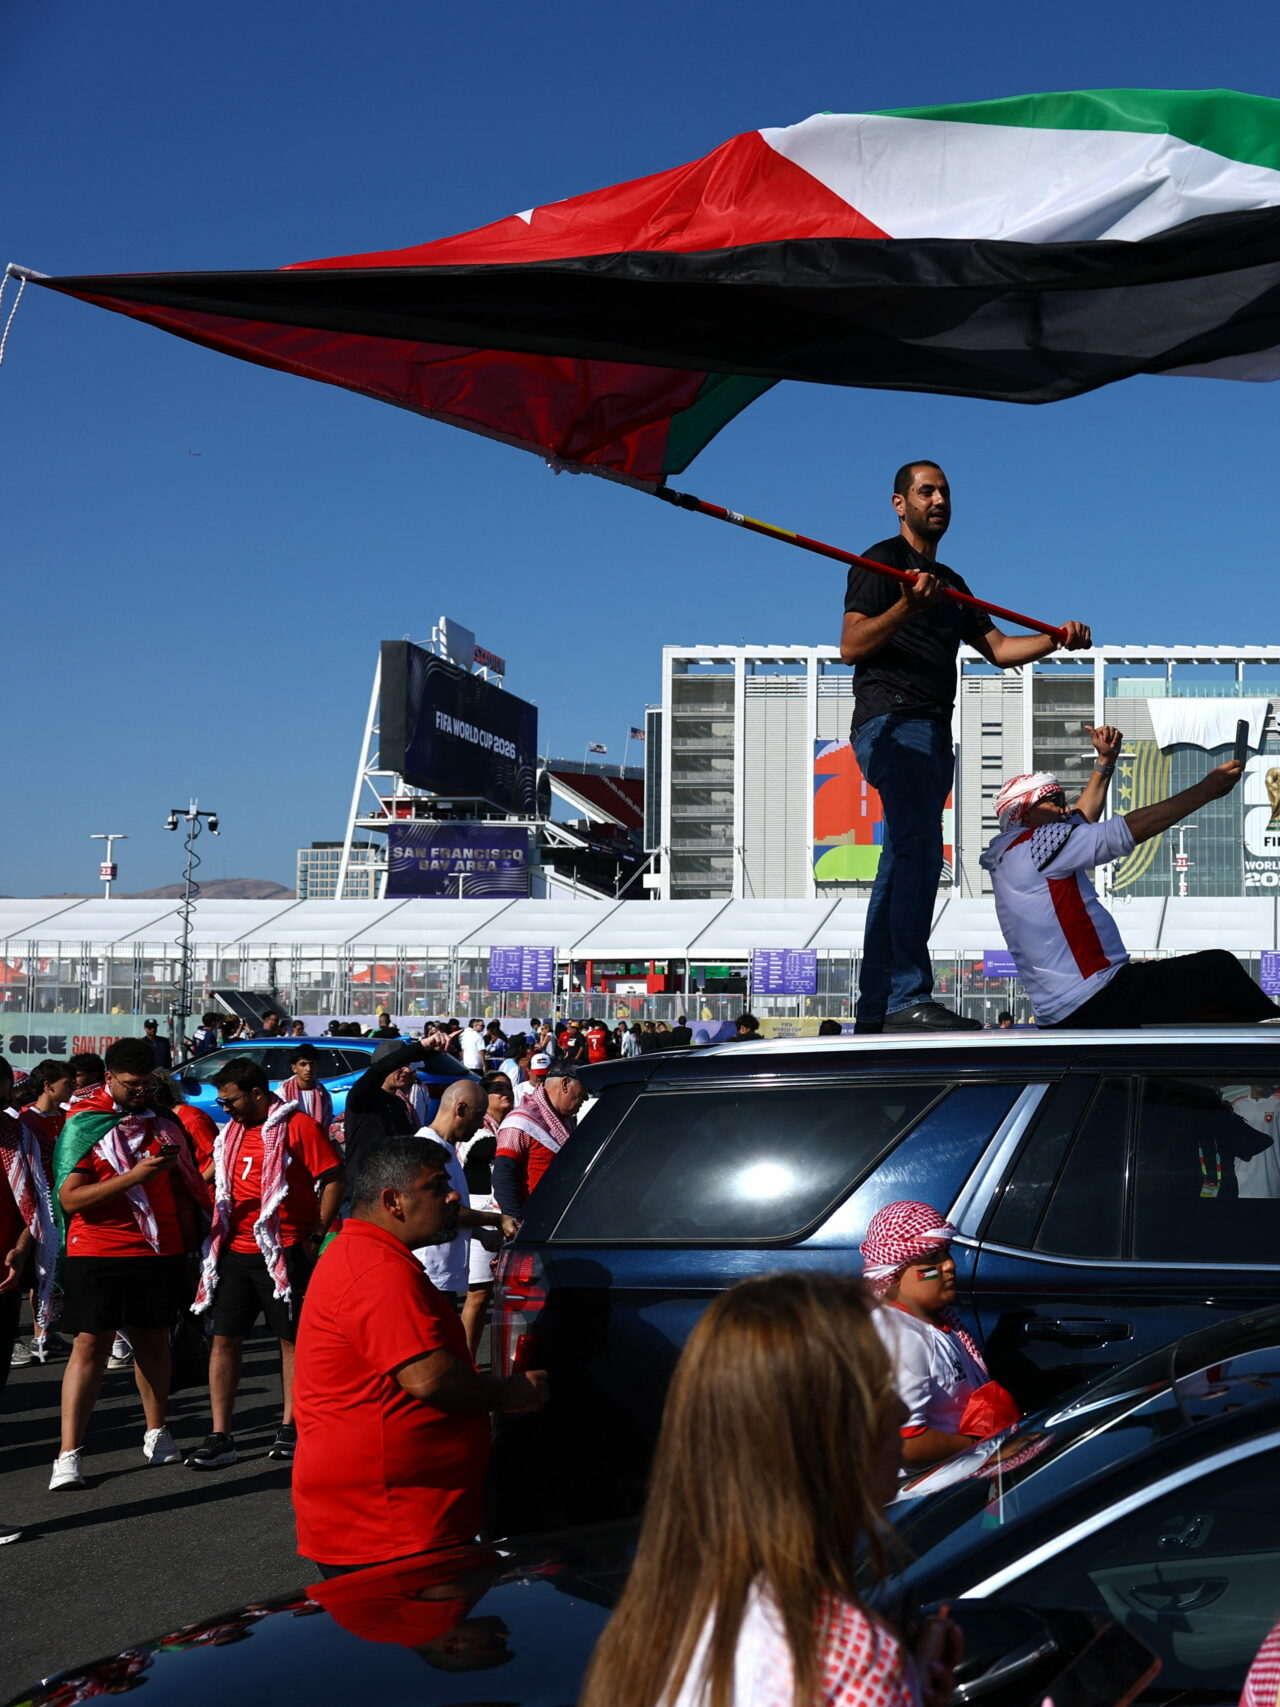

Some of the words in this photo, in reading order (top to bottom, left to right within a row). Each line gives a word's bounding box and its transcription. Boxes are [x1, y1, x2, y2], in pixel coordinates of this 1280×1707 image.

[435, 711, 452, 734] FIFA
[453, 717, 479, 744] WORLD
[480, 729, 493, 750] CUP
[493, 735, 517, 760] 2026
[393, 847, 427, 859] SAN
[431, 847, 524, 861] FRANCISCO
[454, 860, 498, 872] AREA
[71, 1035, 97, 1056] SAN
[241, 1156, 253, 1181] 7
